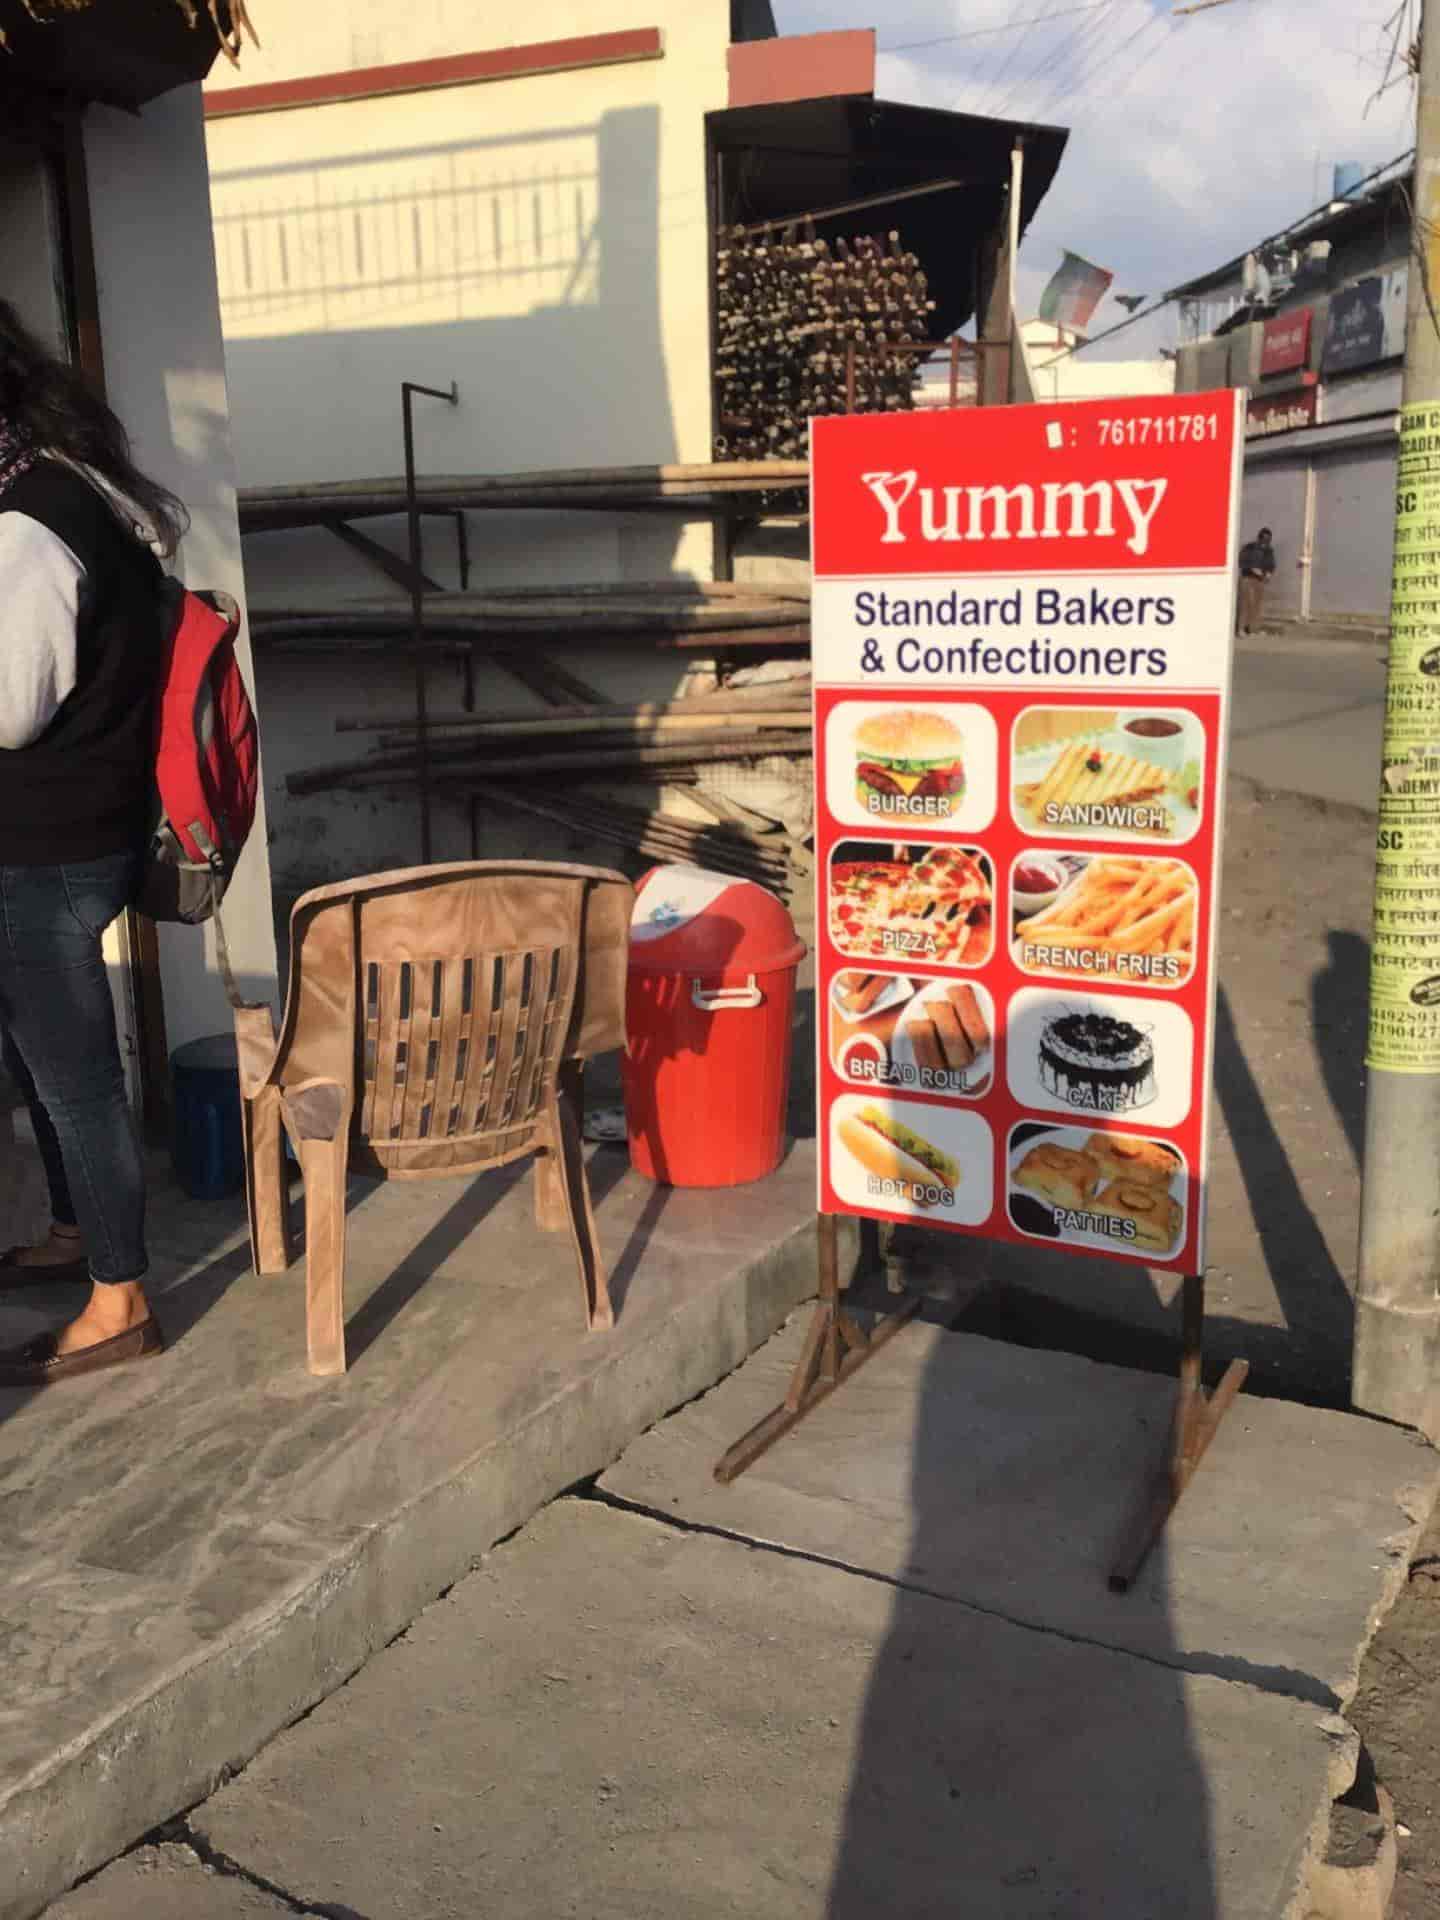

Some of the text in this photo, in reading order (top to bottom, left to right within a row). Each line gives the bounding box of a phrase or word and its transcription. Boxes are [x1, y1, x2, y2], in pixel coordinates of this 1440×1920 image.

[1097, 413, 1218, 446] 761711781
[861, 470, 1168, 555] Yummy
[854, 587, 1176, 627] Standard Bakers
[860, 637, 1168, 676] & Confectioners
[868, 794, 952, 817] BURGER
[1045, 803, 1167, 829] SANDWICH
[881, 930, 938, 954] PIZZA
[1023, 943, 1179, 978] FRENCH FRIES
[849, 1058, 971, 1091] BREAD ROLL
[1067, 1087, 1128, 1112] CAKE
[867, 1175, 955, 1207] HOT DOG
[1053, 1209, 1137, 1239] PATTIES
